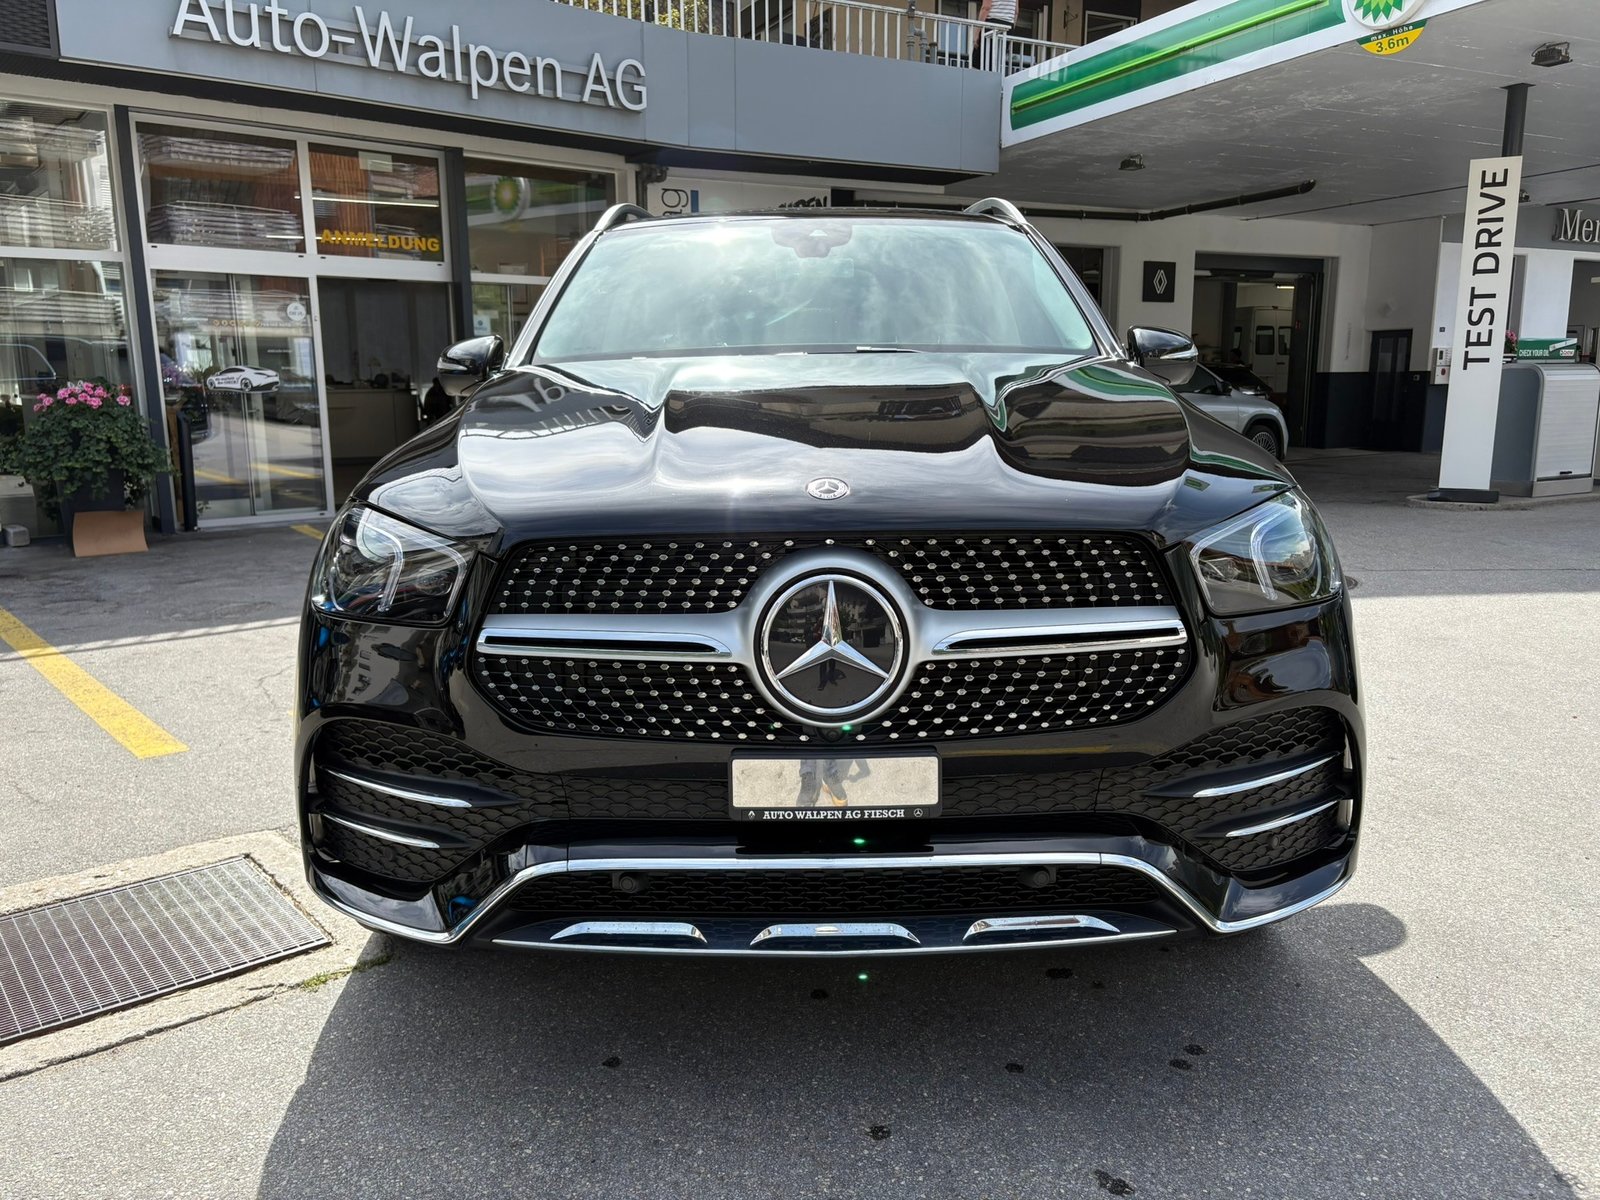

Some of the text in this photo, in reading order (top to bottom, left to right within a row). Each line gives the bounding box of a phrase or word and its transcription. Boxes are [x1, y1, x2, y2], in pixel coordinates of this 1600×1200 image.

[1370, 33, 1390, 42] max.
[1375, 36, 1410, 53] 3.6m
[172, 0, 648, 112] Auto-Walpen AG
[320, 229, 440, 253] ANMELDUNG
[1462, 167, 1509, 371] TEST DRIVE
[1518, 349, 1532, 357] CHECK
[762, 809, 905, 820] AUTO WALPEN AG FIESCH
